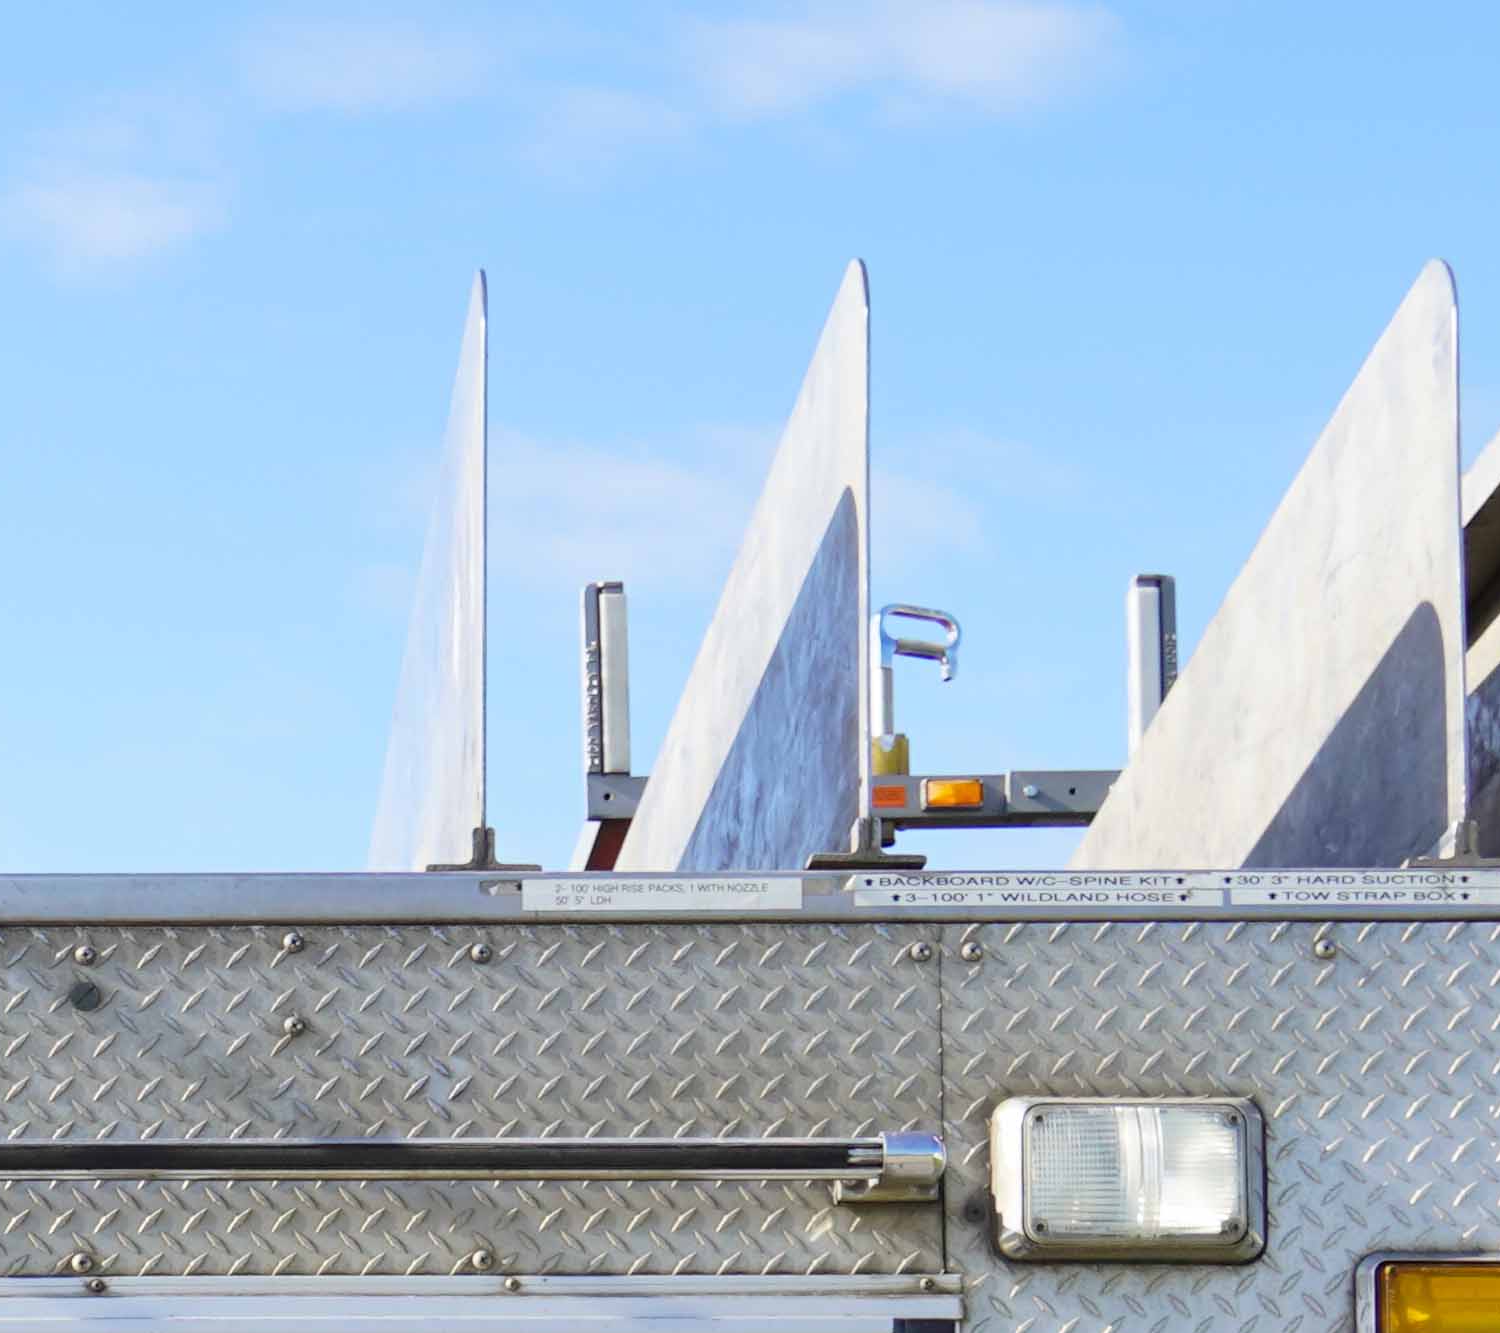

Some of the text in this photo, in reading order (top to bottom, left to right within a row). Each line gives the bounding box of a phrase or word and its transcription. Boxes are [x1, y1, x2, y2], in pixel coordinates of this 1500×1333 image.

[879, 875, 1173, 887] BACKBOARD W/C-SPINE KIT
[1296, 875, 1355, 885] HARD
[1360, 875, 1456, 885] SUCTION
[592, 884, 618, 894] HIGH
[621, 884, 645, 894] RISE
[696, 883, 725, 893] WITH
[727, 883, 769, 893] NOZZLE
[590, 896, 612, 905] LDH
[1000, 891, 1110, 903] WILDLAND
[1116, 891, 1176, 903] HOSE
[1283, 890, 1456, 901] TOW STRAP BOX
